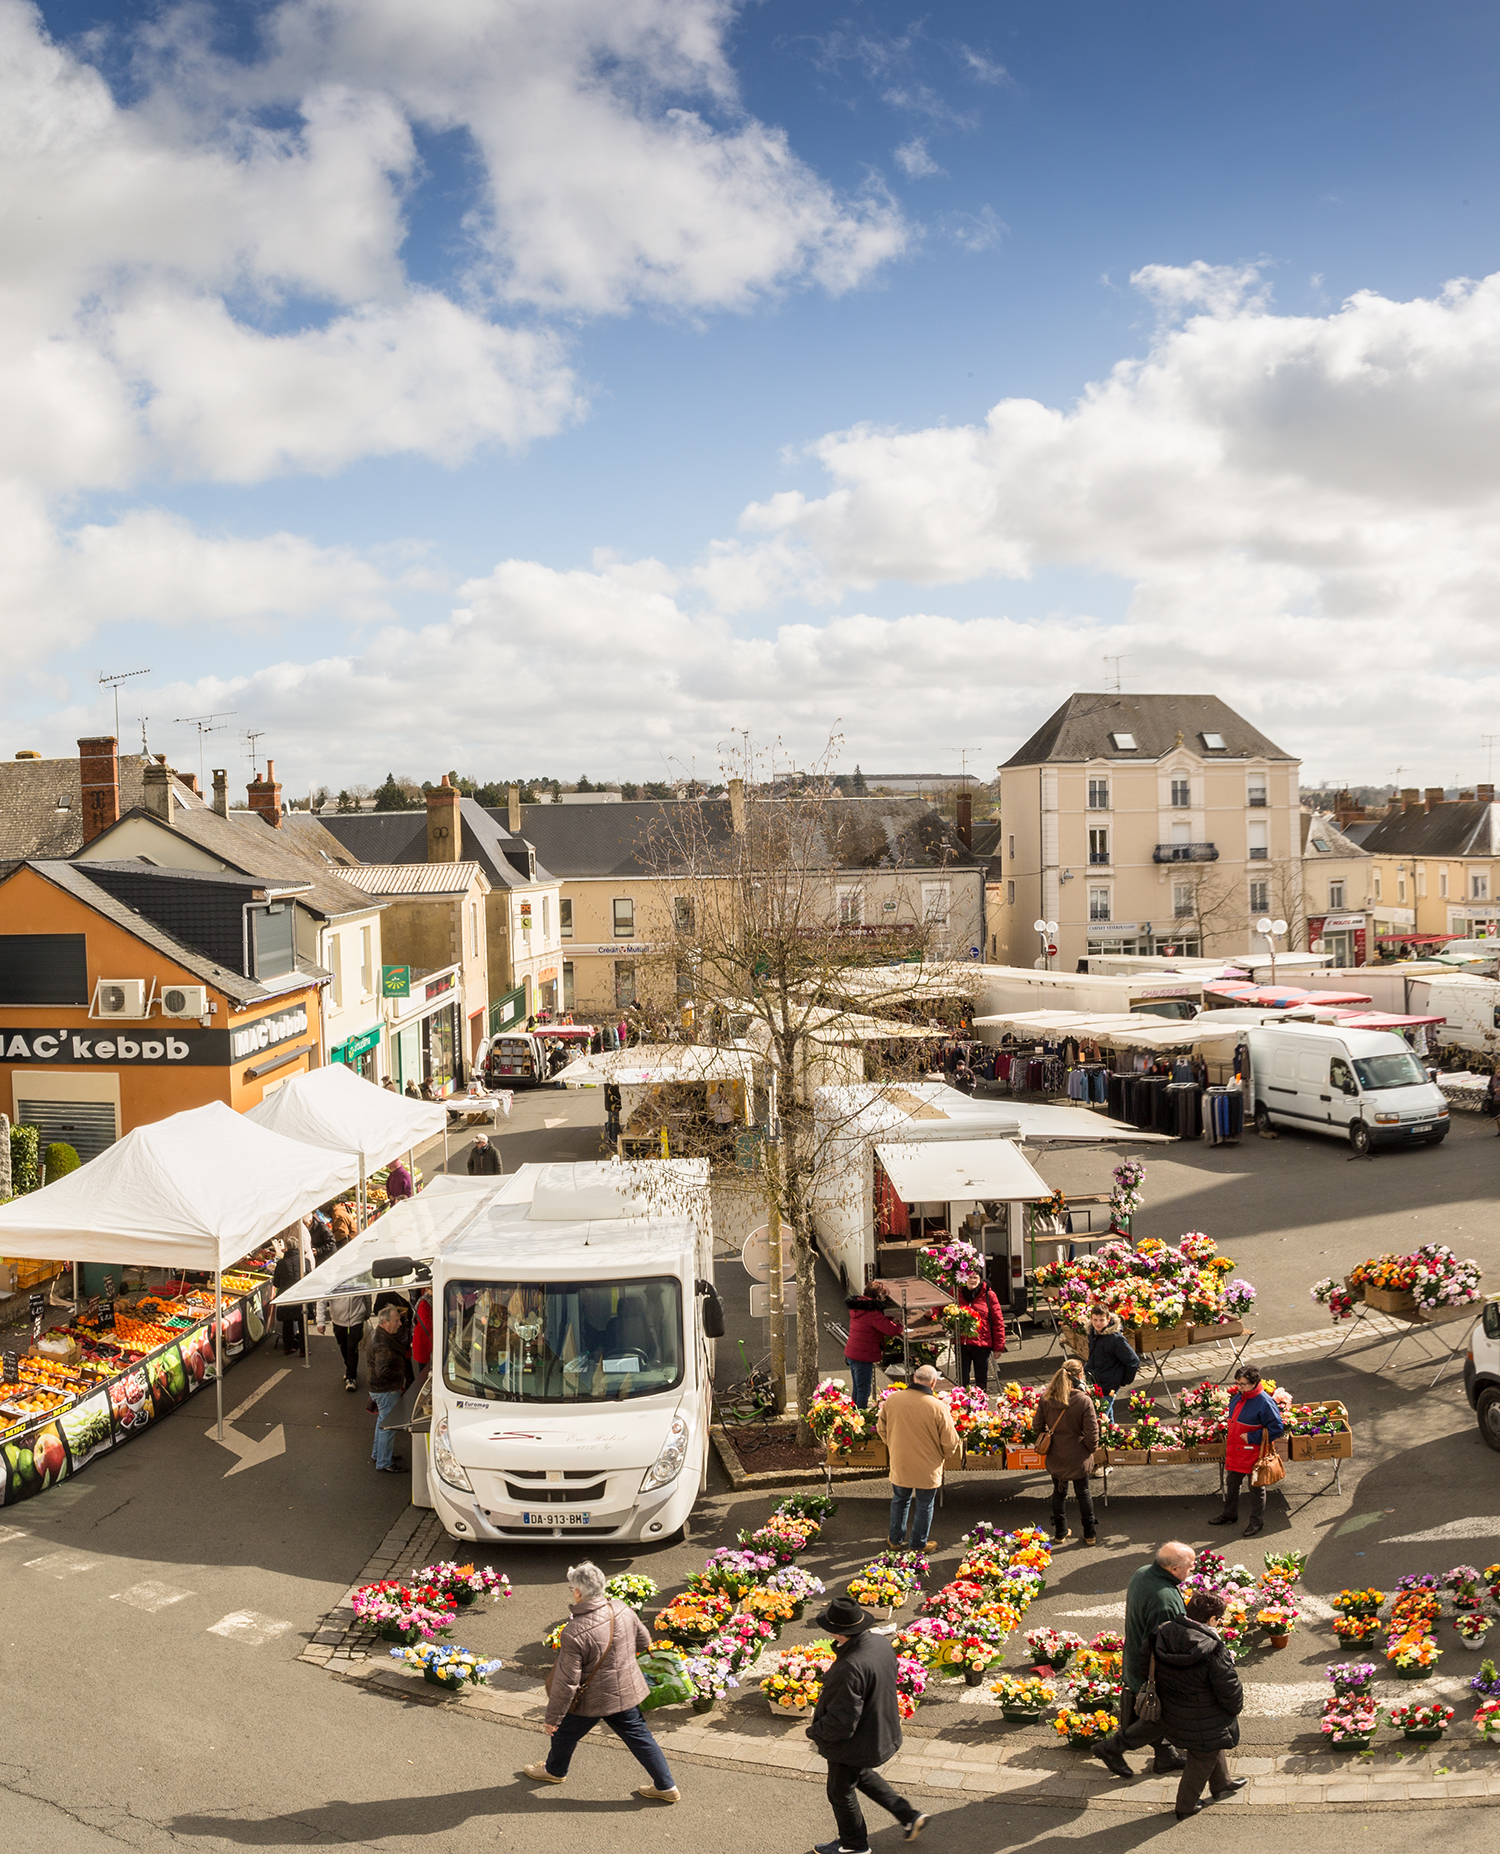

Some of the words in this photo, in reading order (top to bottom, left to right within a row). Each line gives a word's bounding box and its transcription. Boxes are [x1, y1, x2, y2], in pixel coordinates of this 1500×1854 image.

[1141, 987, 1190, 998] CHAUSSURES
[465, 1401, 489, 1409] Euromag
[531, 1514, 582, 1524] DA-913-BM
